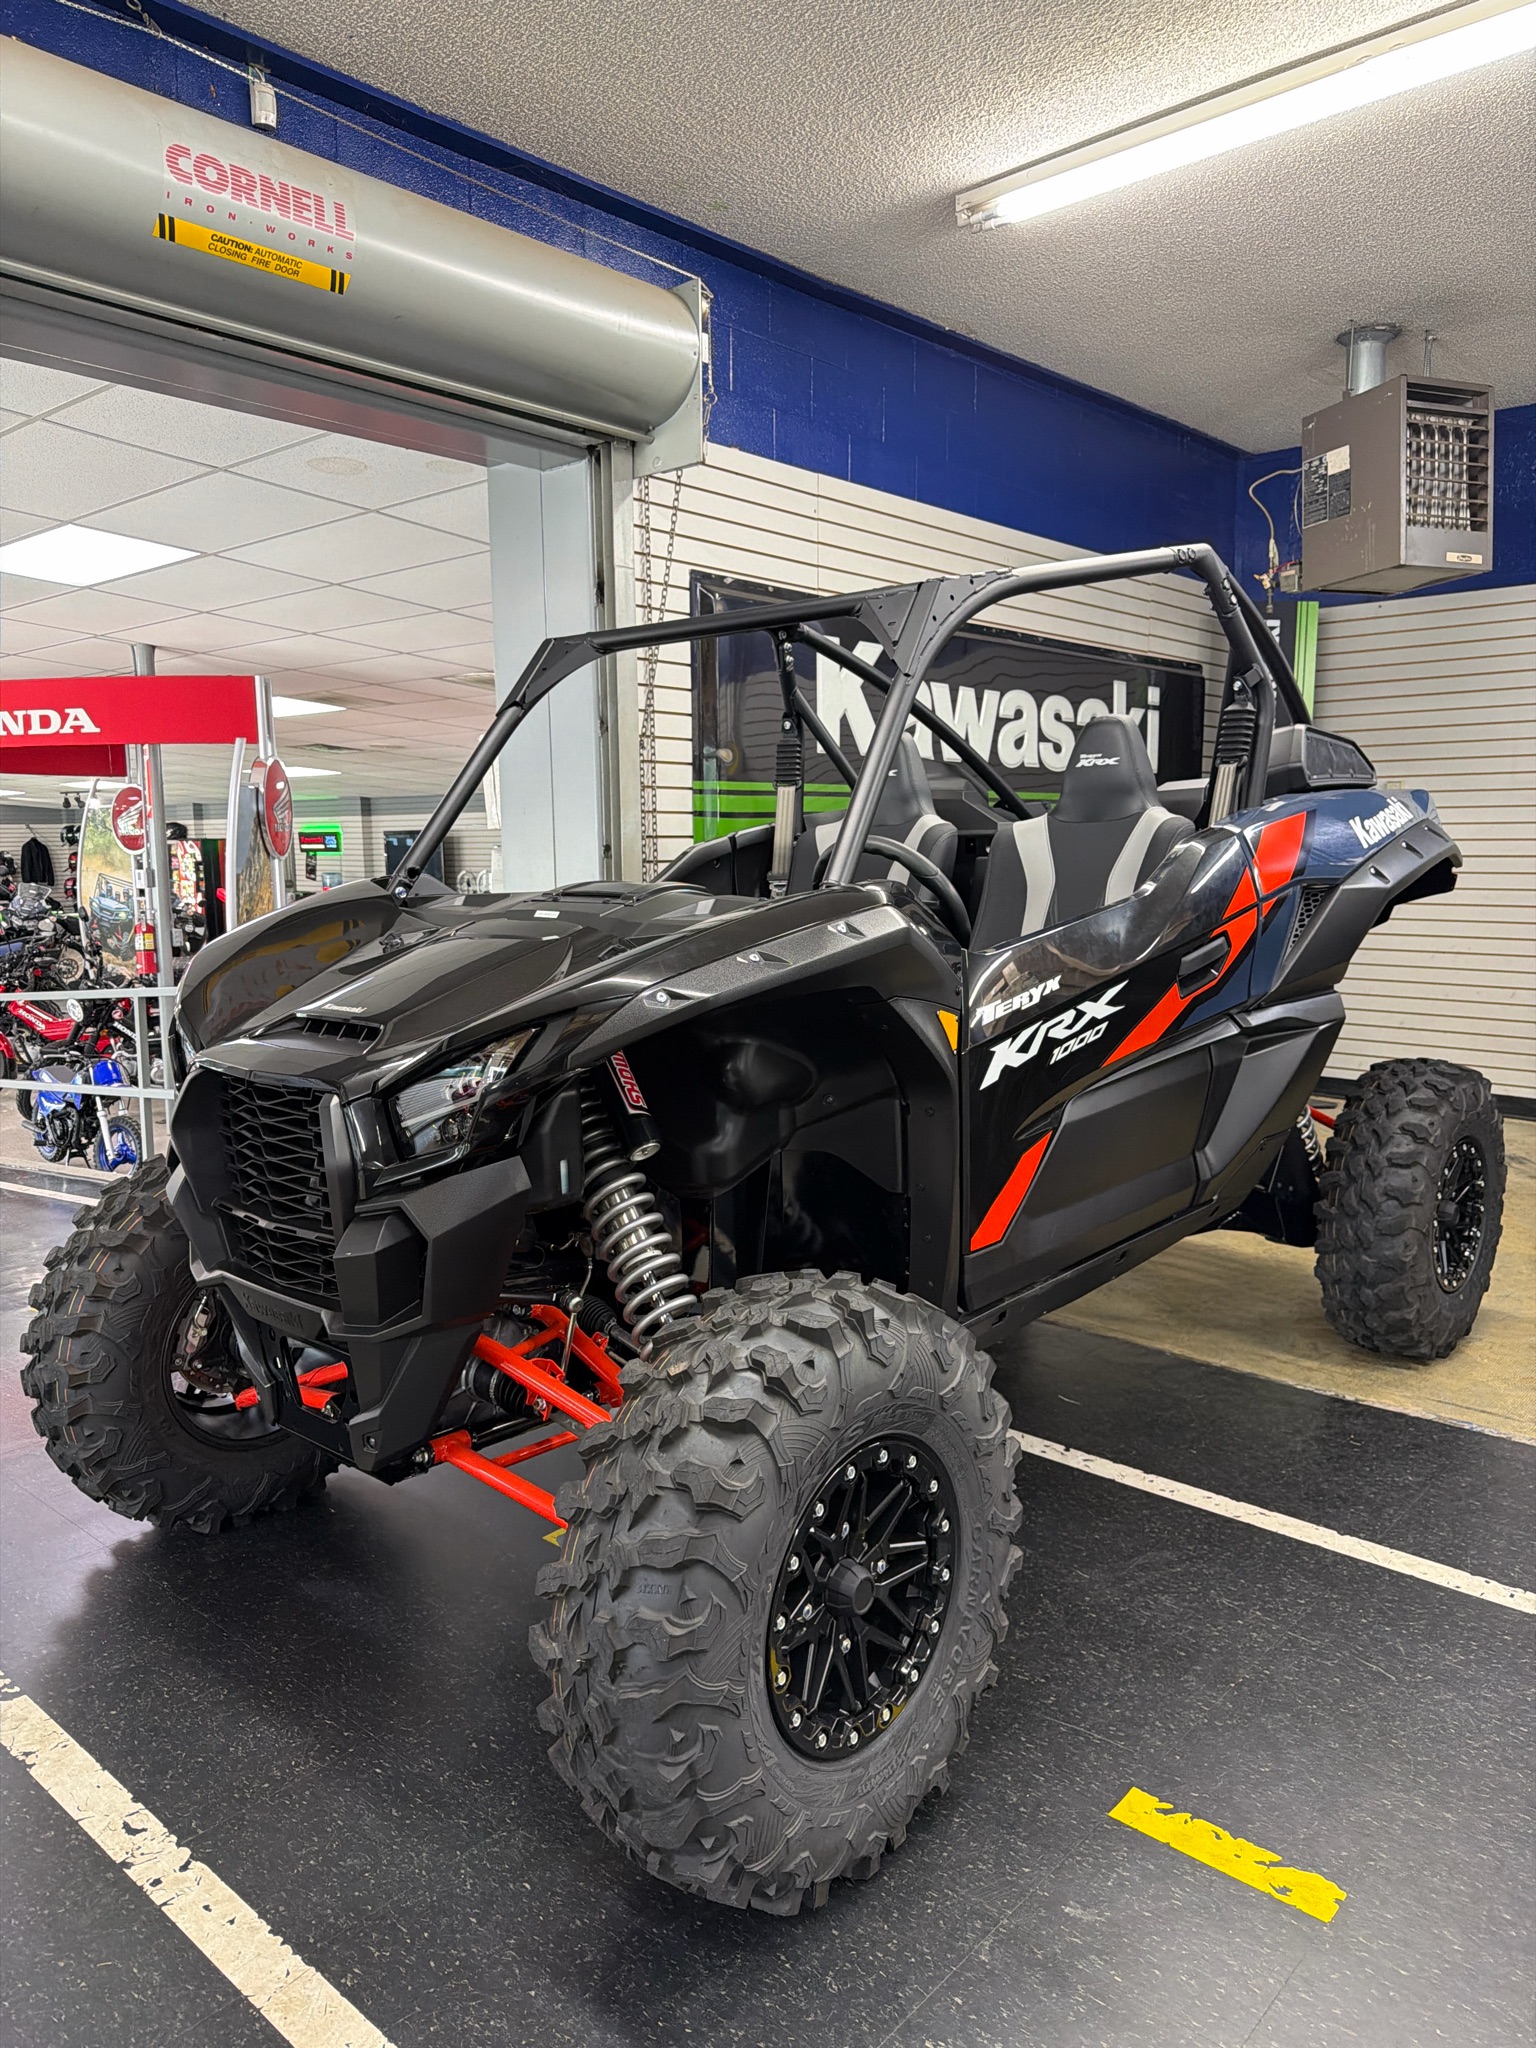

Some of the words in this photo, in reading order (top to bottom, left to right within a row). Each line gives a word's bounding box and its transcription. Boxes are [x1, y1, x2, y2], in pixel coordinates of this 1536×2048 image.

[165, 143, 355, 241] CORNELL
[166, 190, 237, 221] IRON
[265, 224, 353, 260] WORKS
[207, 242, 247, 261] CLOSING
[251, 255, 272, 269] FIRE
[274, 263, 300, 278] DOOR
[210, 234, 254, 254] CAUTION:
[254, 247, 303, 269] AUTOMATIC
[0, 707, 101, 736] NDA
[1348, 796, 1414, 849] Kawasaki
[17, 1009, 46, 1031] HONDA
[980, 979, 1130, 1091] KRX
[1050, 1021, 1110, 1066] 1000
